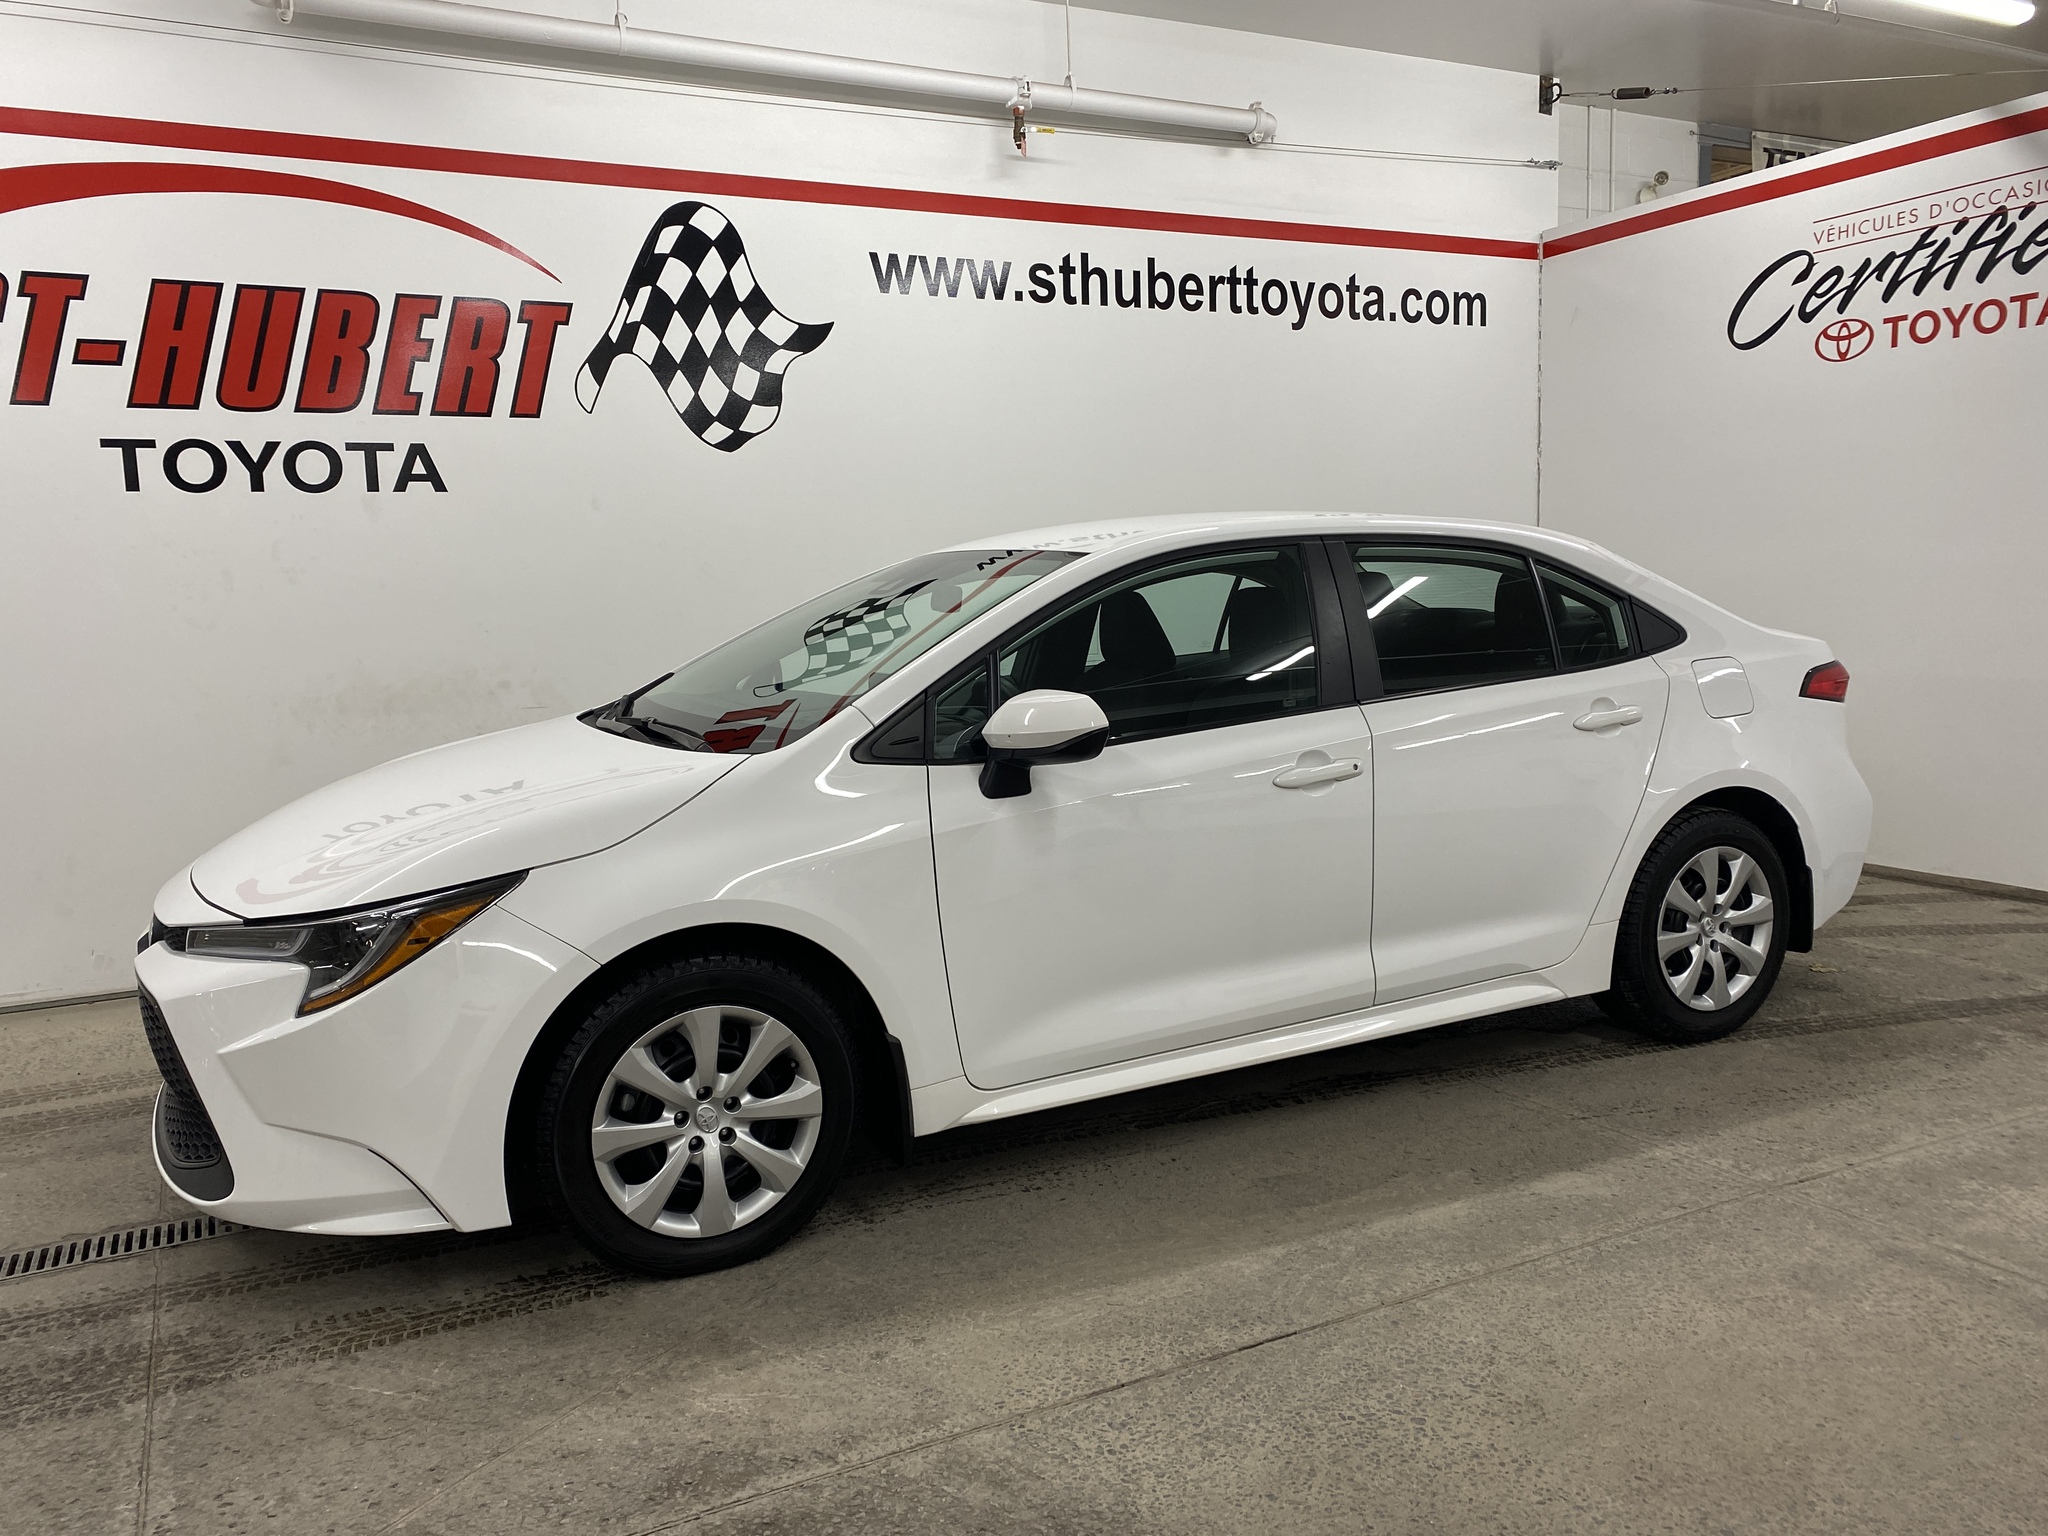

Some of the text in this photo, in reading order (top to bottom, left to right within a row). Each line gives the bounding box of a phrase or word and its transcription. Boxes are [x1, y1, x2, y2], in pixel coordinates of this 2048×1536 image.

[1813, 178, 2048, 245] VÉHICULES D'OCCASI
[868, 251, 1489, 331] www.sthuberttoyota.com
[0, 269, 574, 419] T-HUBERT
[99, 437, 449, 494] TOYOTA
